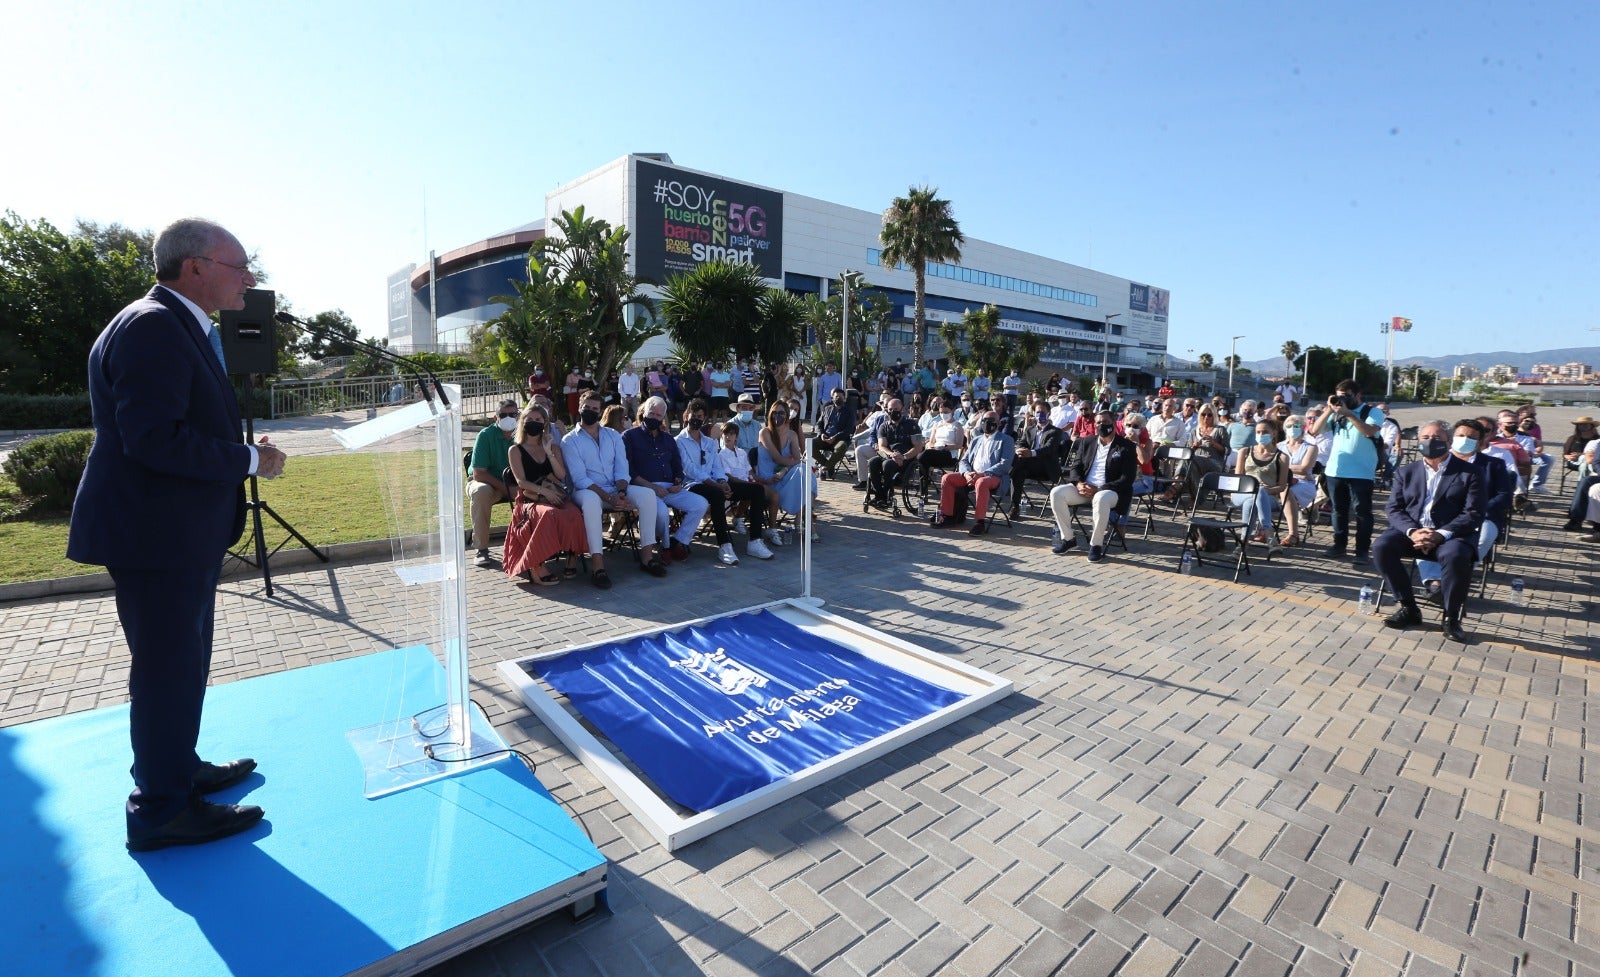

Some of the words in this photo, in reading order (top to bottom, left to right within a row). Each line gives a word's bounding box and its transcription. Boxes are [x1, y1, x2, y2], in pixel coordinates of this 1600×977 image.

[653, 179, 715, 212] #SOY
[664, 204, 711, 226] huerto
[712, 199, 727, 246] zen
[729, 203, 767, 237] 5G
[664, 220, 711, 243] barrio
[692, 243, 754, 267] smart
[747, 727, 781, 744] de
